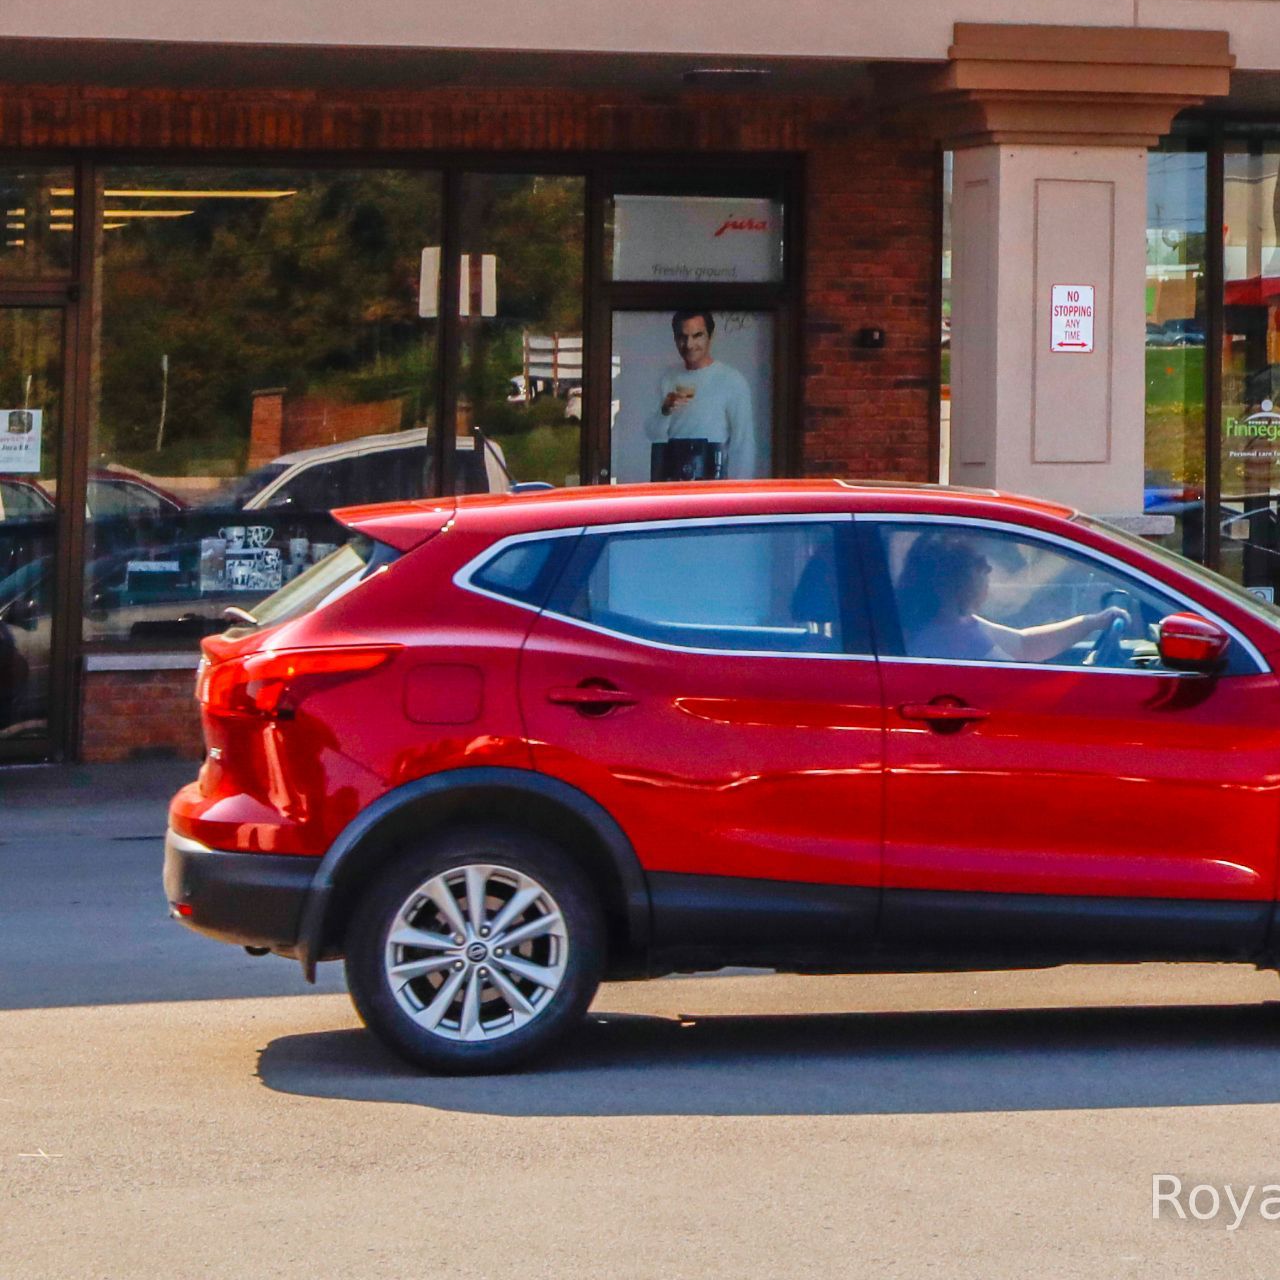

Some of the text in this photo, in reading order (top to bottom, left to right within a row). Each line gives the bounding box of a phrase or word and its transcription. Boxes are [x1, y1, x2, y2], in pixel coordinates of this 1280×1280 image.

[1067, 291, 1079, 302] NO
[1054, 305, 1092, 317] STOPPING
[1065, 319, 1080, 328] ANY
[1064, 330, 1080, 340] TIME
